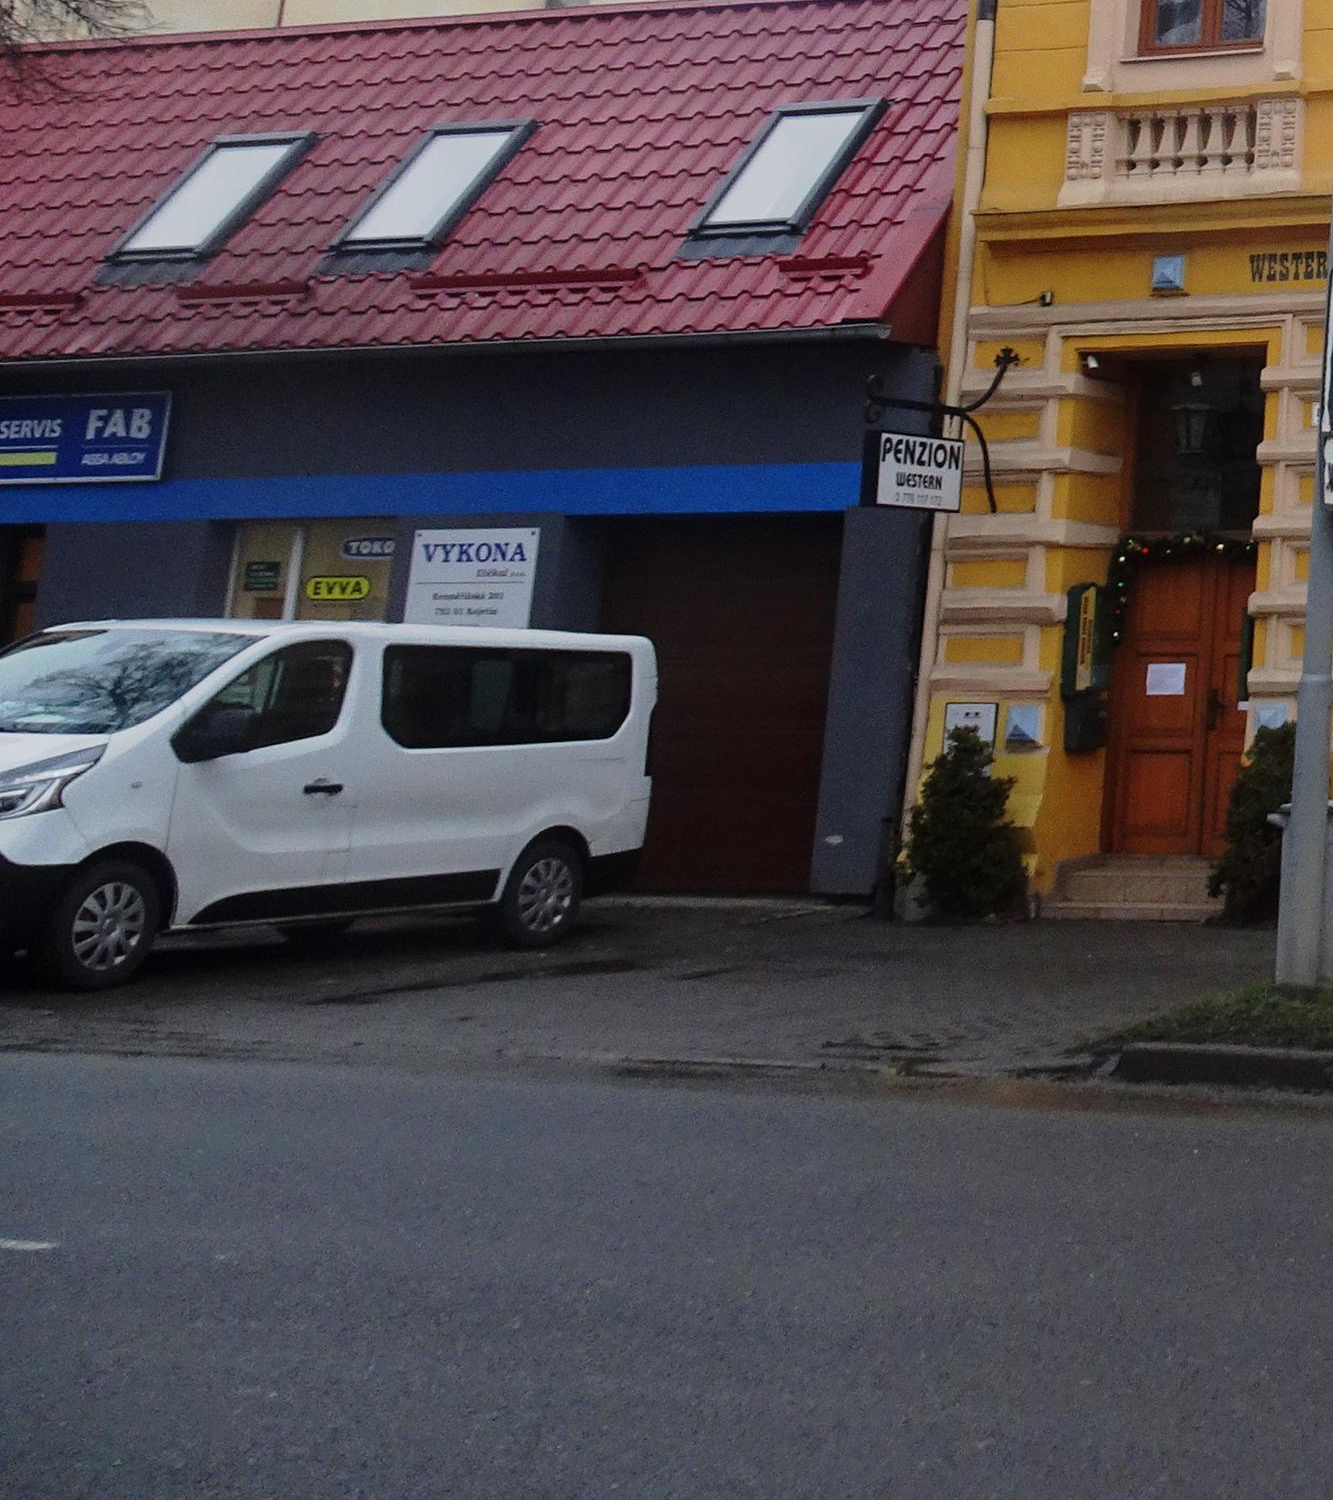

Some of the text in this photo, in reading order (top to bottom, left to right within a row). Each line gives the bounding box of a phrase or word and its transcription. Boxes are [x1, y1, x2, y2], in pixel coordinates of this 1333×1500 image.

[1248, 250, 1330, 283] WESTER
[0, 407, 153, 440] SERVIS FAB
[881, 436, 961, 471] PENZION
[895, 471, 943, 491] WESTERN
[422, 541, 528, 563] VYKONA
[312, 580, 365, 597] EVVA
